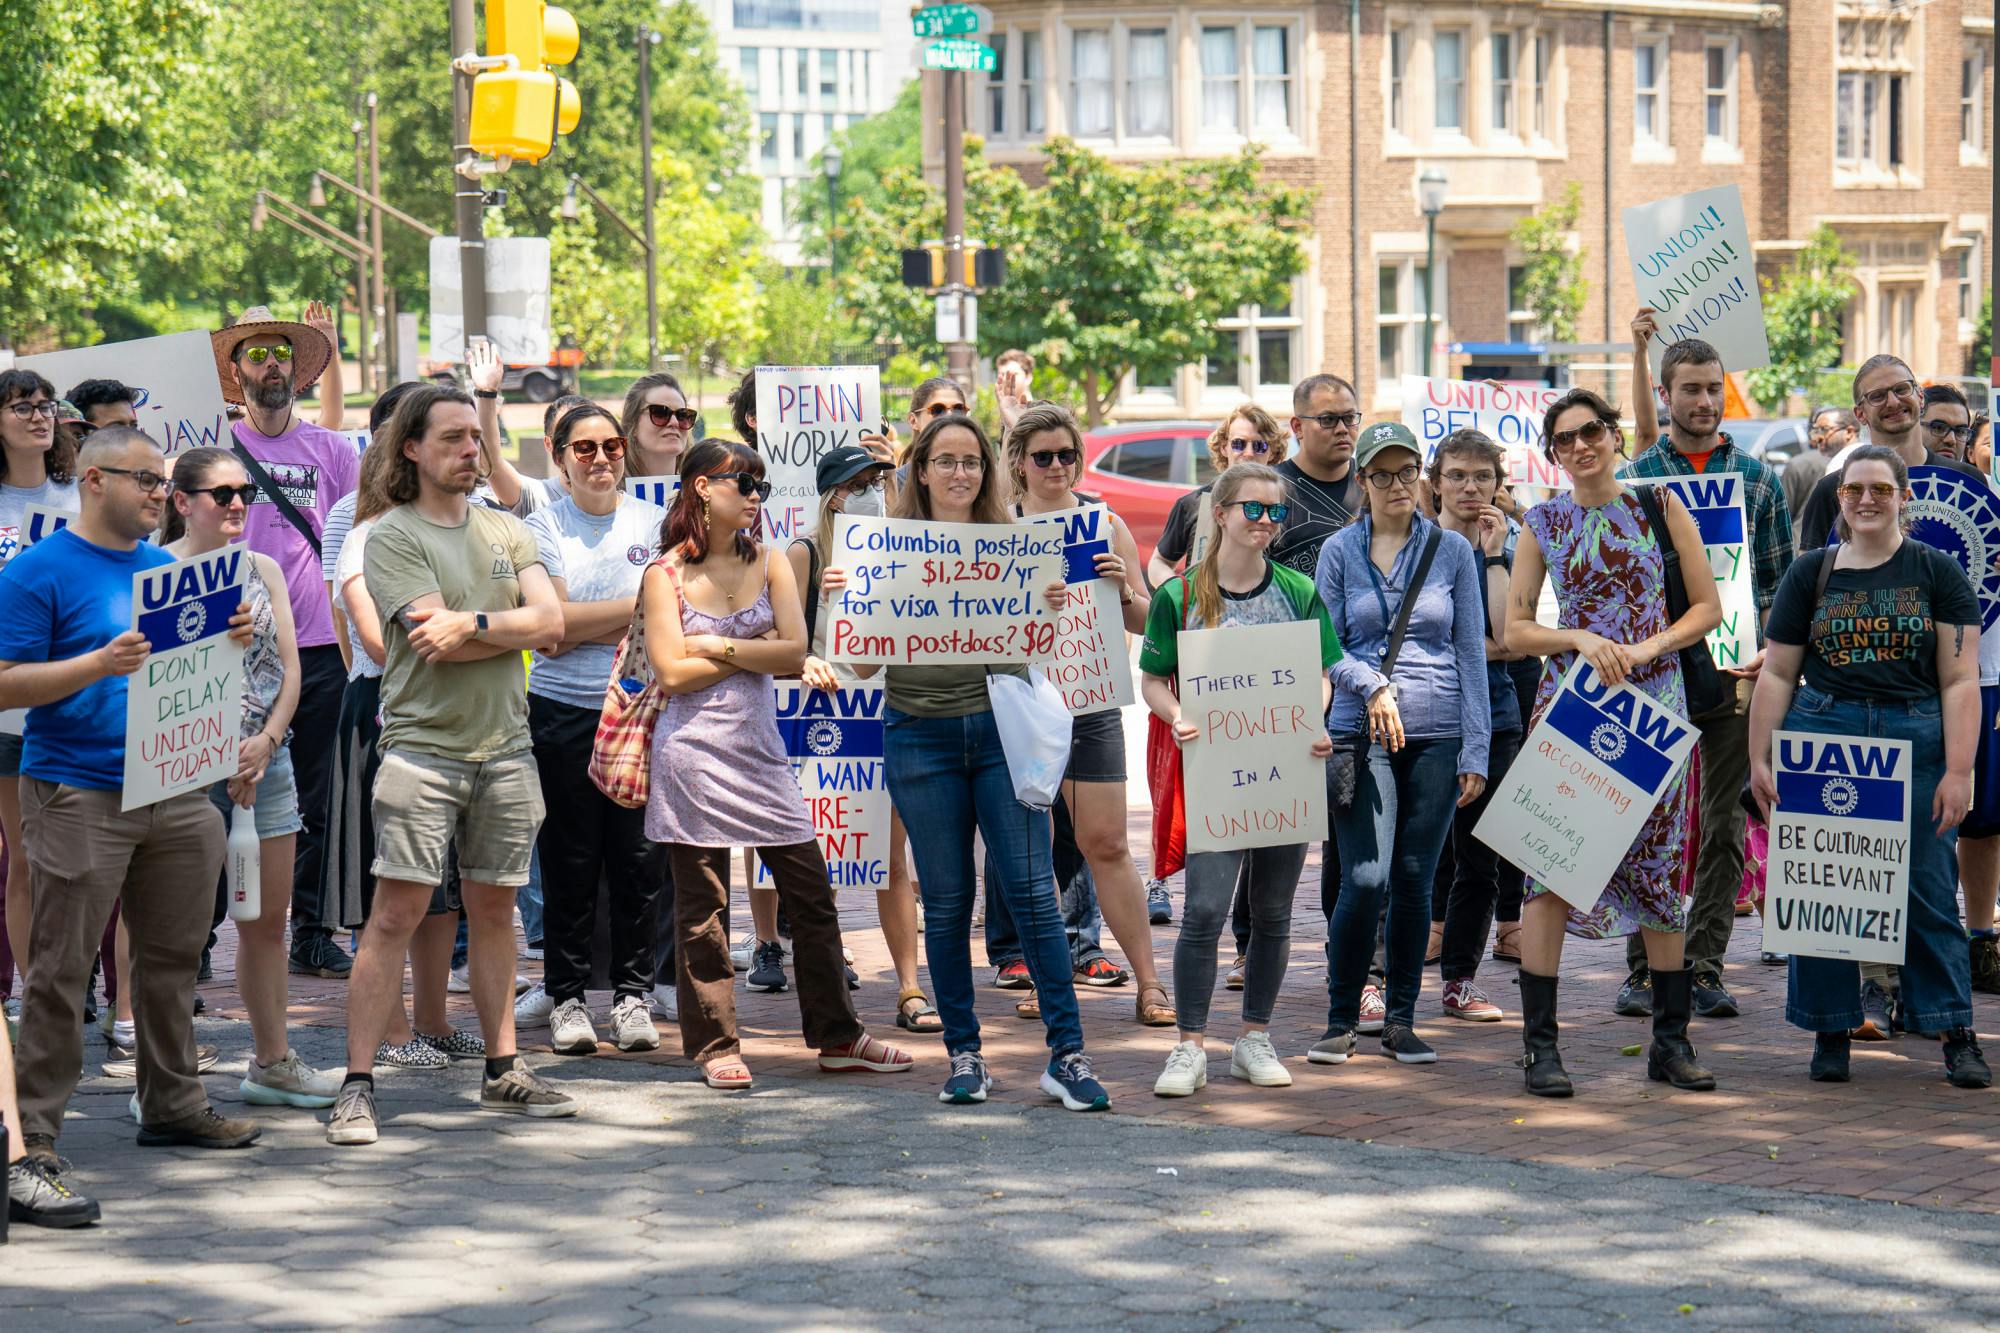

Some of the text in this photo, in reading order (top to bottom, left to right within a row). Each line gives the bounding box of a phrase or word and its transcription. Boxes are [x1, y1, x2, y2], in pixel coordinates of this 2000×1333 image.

[1638, 205, 1725, 277] UNION!
[1649, 240, 1739, 313] UNION!
[1656, 276, 1749, 348] UNION!
[778, 383, 863, 424] PENN
[1427, 380, 1559, 415] UNIONS
[1423, 407, 1547, 445] BEON
[769, 474, 817, 498] becau
[1906, 503, 1930, 514] ERICA
[1932, 504, 1961, 523] UNITED
[846, 524, 1064, 566] Columbia postdocs
[142, 550, 242, 611] UAW
[856, 560, 907, 596] get
[1873, 586, 1919, 606] JUST
[184, 615, 200, 629] UAW
[839, 589, 881, 616] for
[891, 594, 939, 618] visa
[948, 591, 1043, 618] travel.
[1814, 601, 1931, 620] ANNA HAVE
[834, 619, 1055, 664] Penn postdocs? $0
[1811, 616, 1934, 636] NDING FOR
[1815, 632, 1924, 654] SCIENTIFIC
[149, 644, 216, 688] DON'T
[1187, 669, 1296, 696] THERE IS
[775, 688, 885, 718] UAW
[1572, 662, 1688, 754] UAW
[141, 710, 223, 762] UNION
[816, 734, 832, 743] UAW
[1207, 705, 1313, 745] POWER
[1600, 735, 1616, 750] UAW
[154, 735, 234, 787] TODAY!
[817, 761, 886, 792] WANT
[1269, 766, 1281, 782] A
[1538, 739, 1632, 815] accounting
[1780, 739, 1901, 778] UAW
[1556, 781, 1577, 799] for
[1831, 792, 1848, 802] UAW
[1205, 799, 1308, 839] UNION!
[1512, 783, 1585, 856] thriving
[1520, 831, 1577, 873] wages
[1778, 825, 1907, 864] BE CULTURALLY
[1784, 860, 1895, 895] RELEVANT
[1775, 897, 1901, 943] UNIONIZE!
